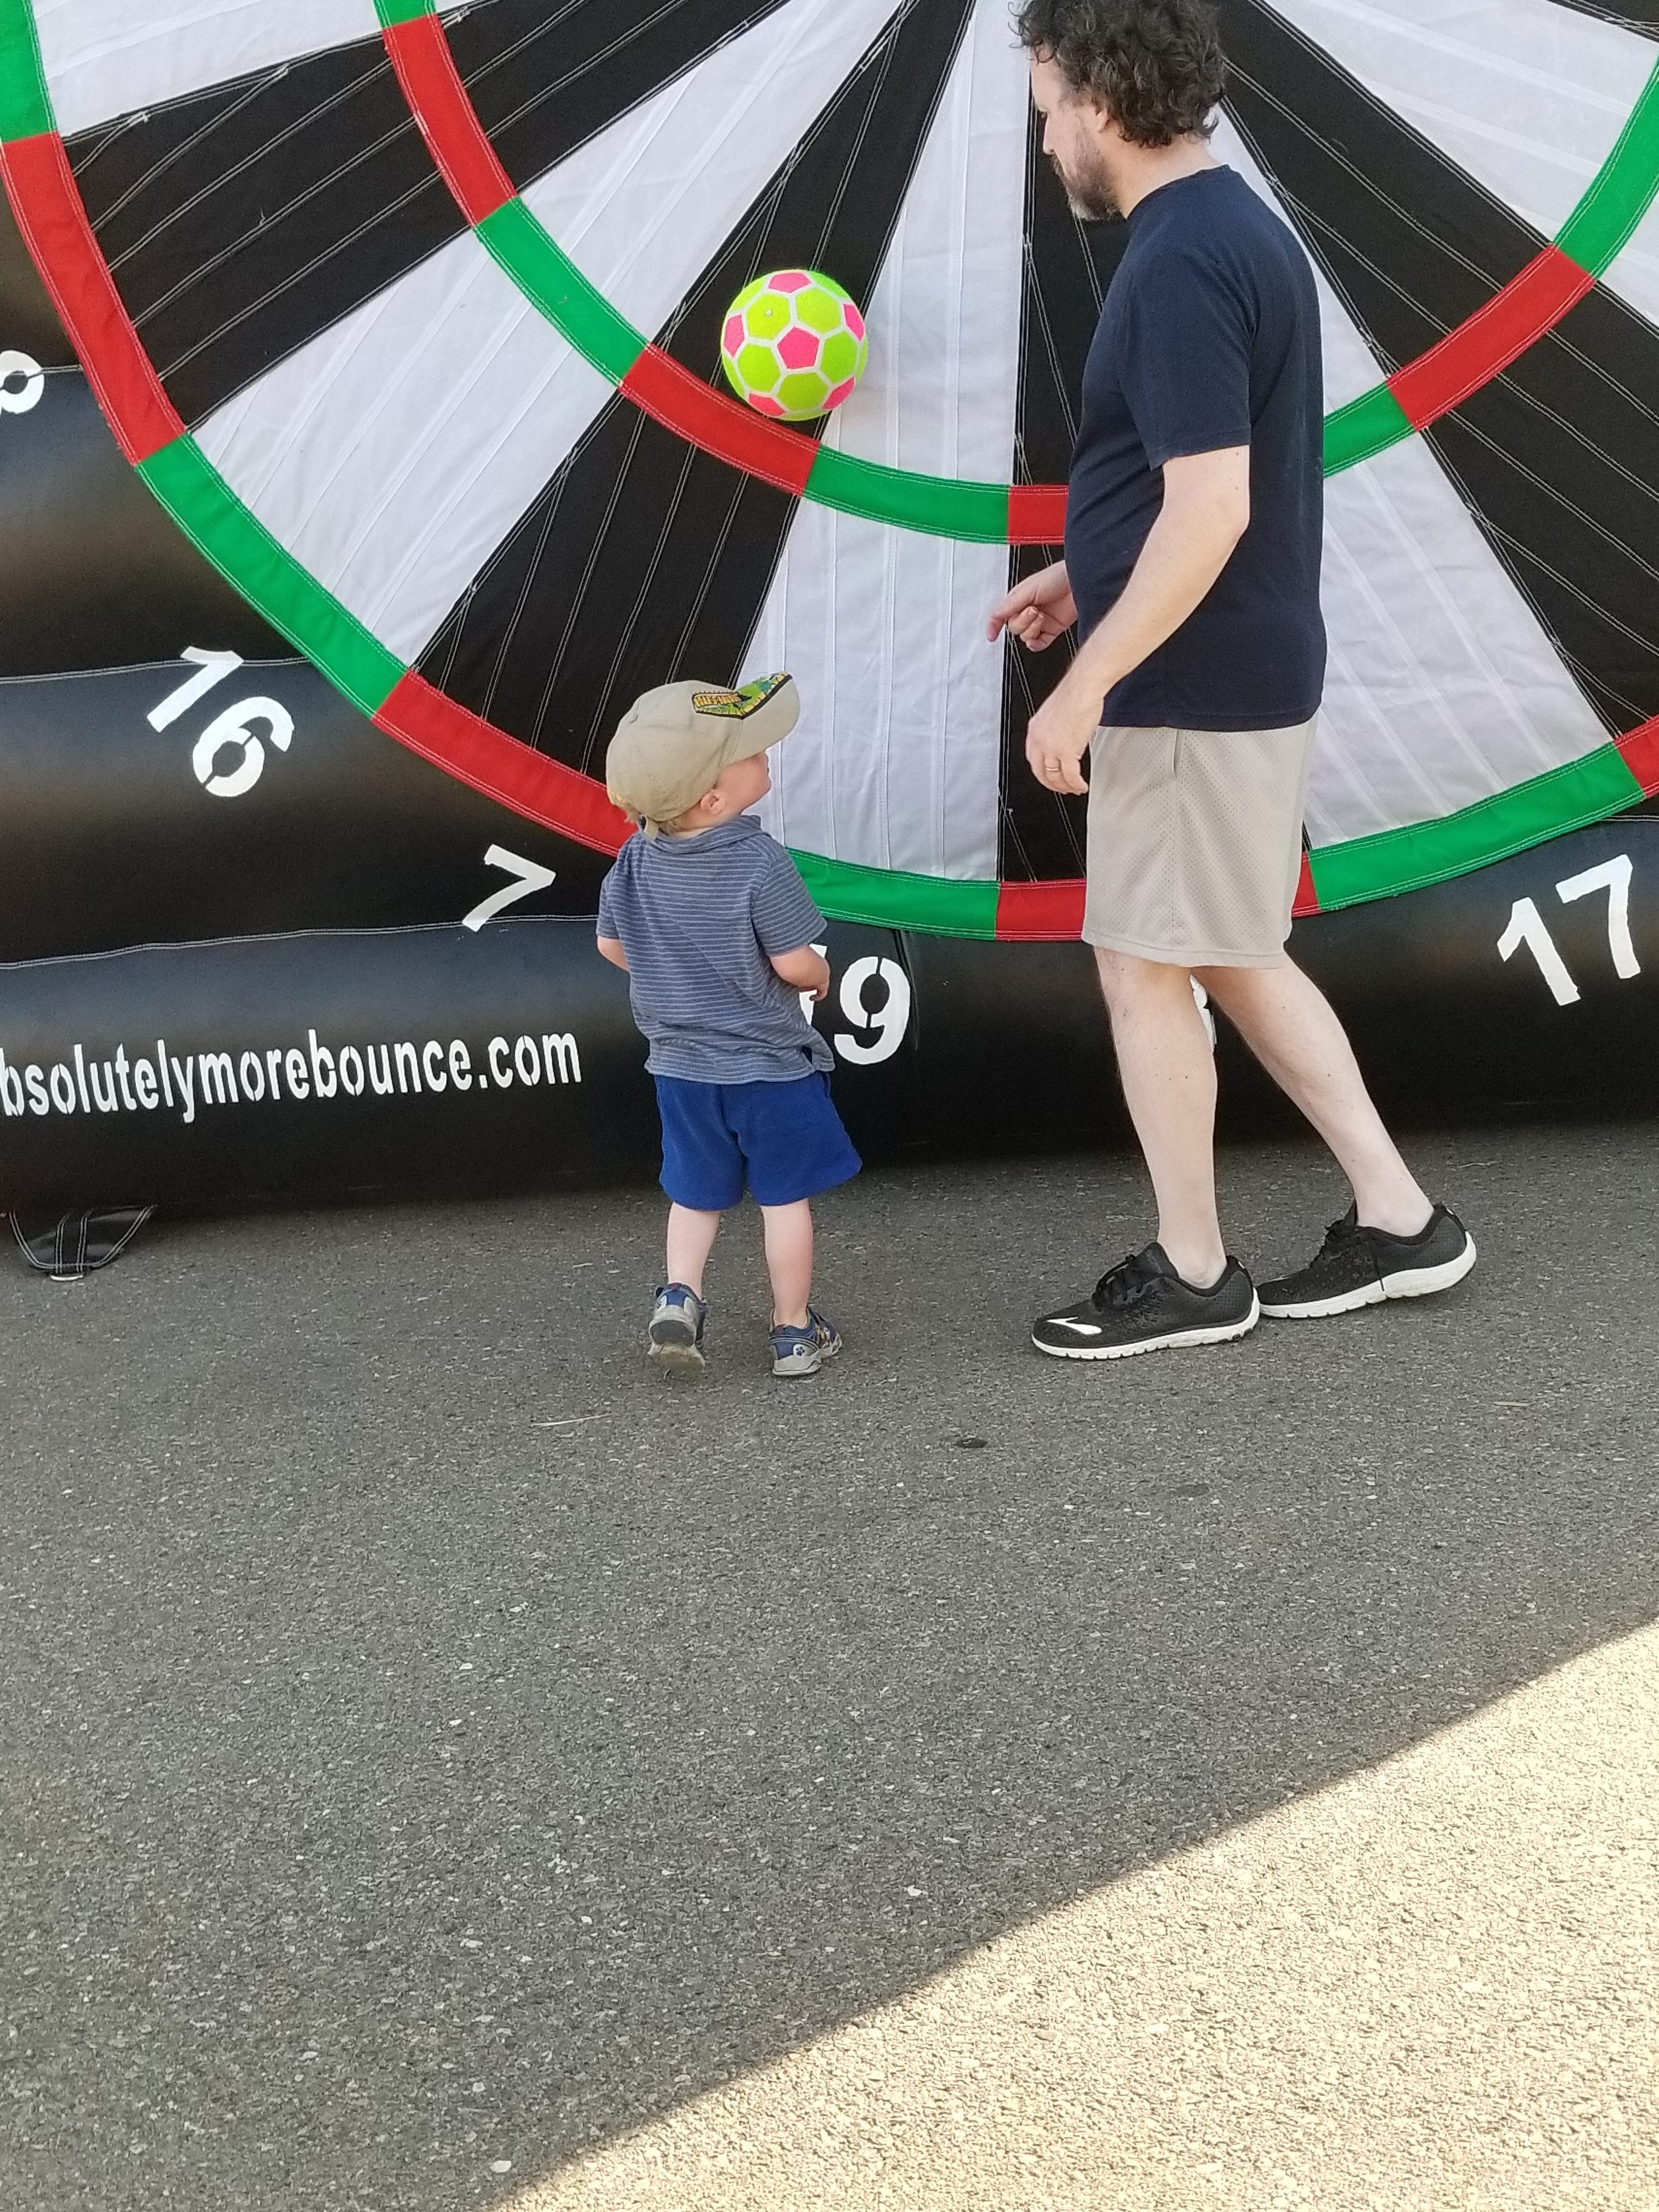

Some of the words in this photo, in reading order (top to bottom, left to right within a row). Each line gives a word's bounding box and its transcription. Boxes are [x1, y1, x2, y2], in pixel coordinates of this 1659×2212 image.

[147, 646, 295, 798] 16
[460, 844, 556, 932] 7
[1497, 854, 1641, 1006] 17
